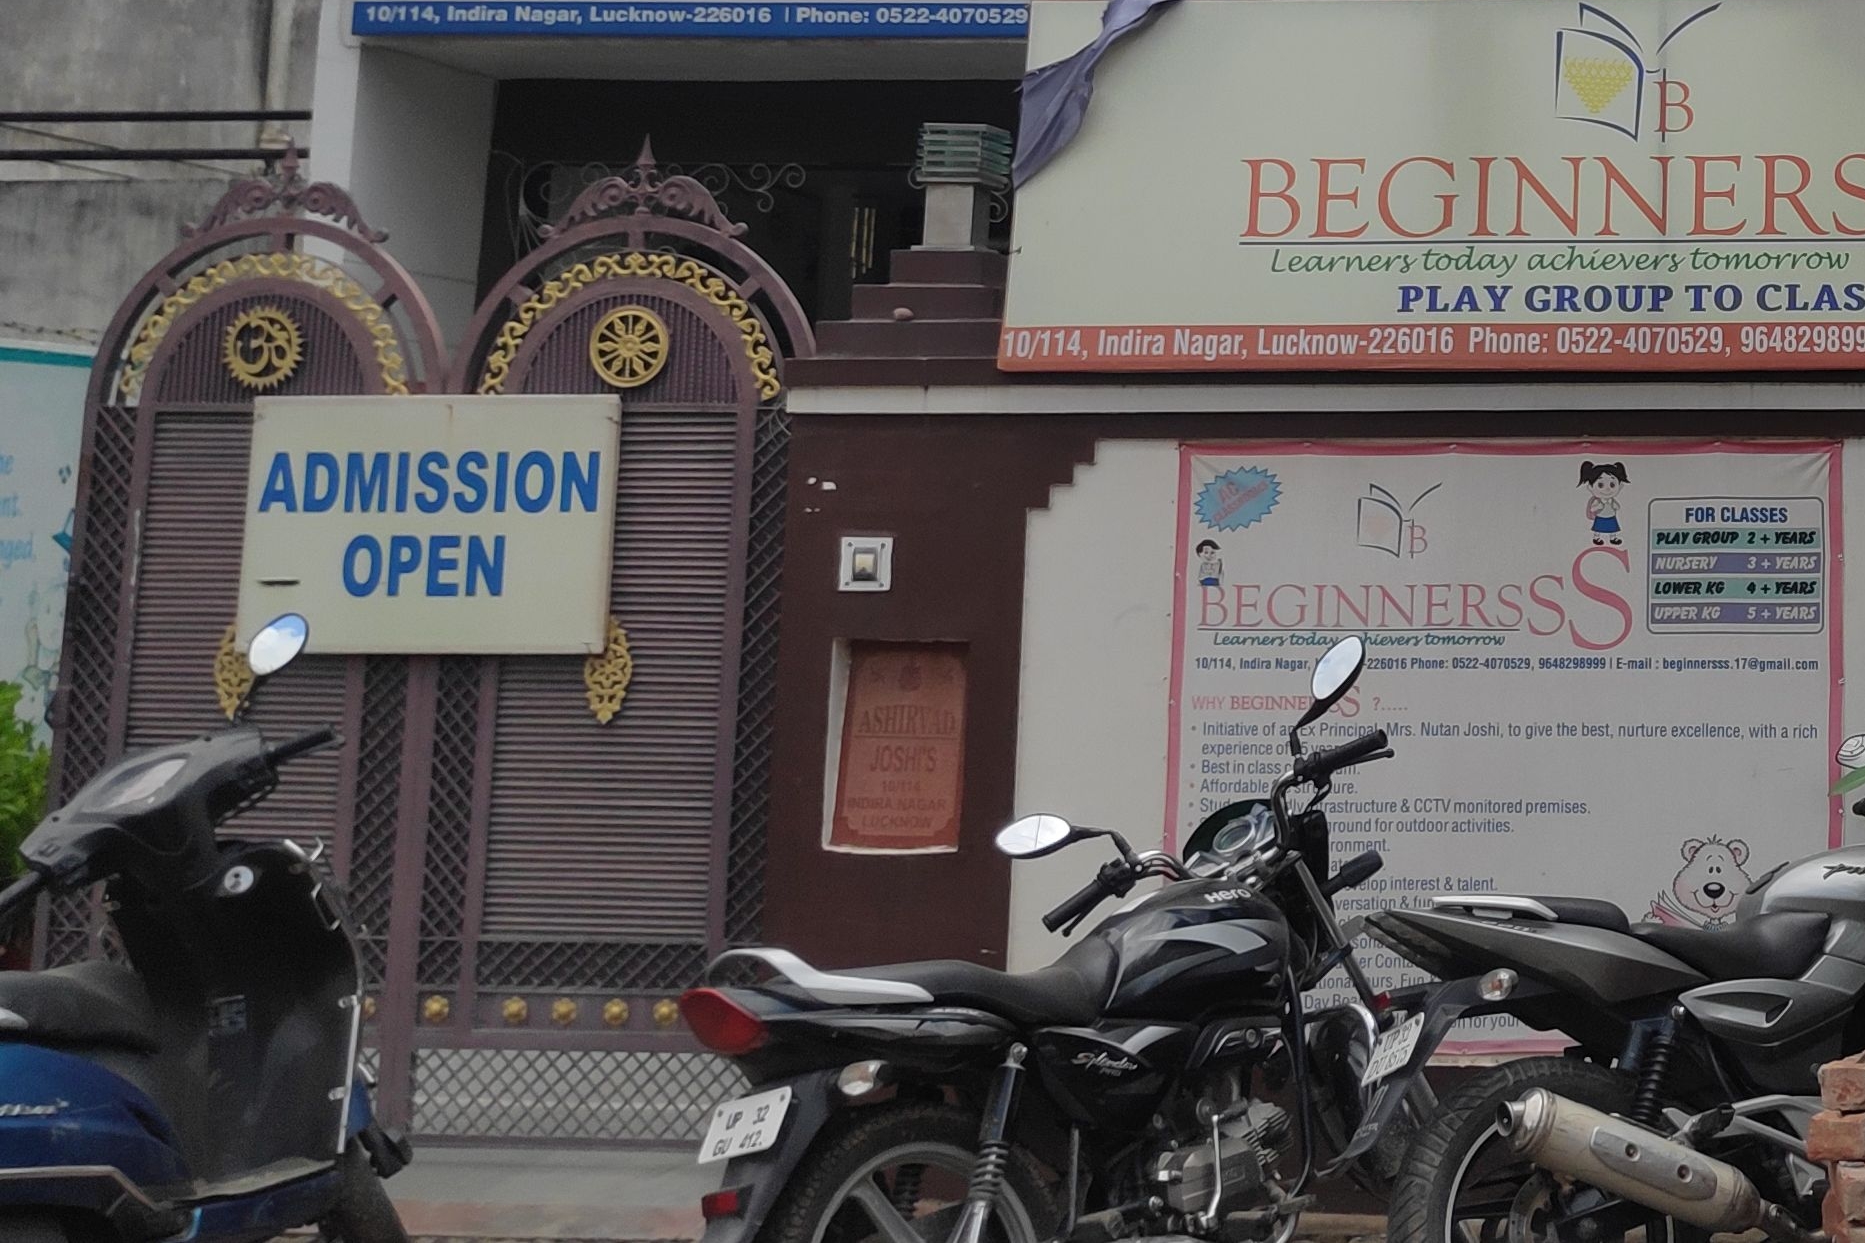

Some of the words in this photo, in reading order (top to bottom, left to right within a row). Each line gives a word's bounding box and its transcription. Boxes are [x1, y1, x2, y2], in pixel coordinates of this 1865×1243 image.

[366, 7, 440, 25] 10/114,
[447, 6, 507, 22] Indira
[515, 6, 583, 25] Nagar,
[590, 7, 771, 23] Lucknow-226016
[796, 8, 869, 23] Phone:
[1271, 247, 1416, 273] Learners
[1422, 247, 1518, 277] today
[1527, 246, 1688, 272] achievers
[1691, 248, 1849, 271] tomorrow
[1397, 285, 1513, 312] PLAY
[1524, 285, 1673, 313] GROUP
[1685, 284, 1742, 313] TO
[1004, 331, 1088, 360] 10/114,
[1098, 329, 1164, 357] Indira
[1174, 331, 1247, 361] Nagar,
[1258, 326, 1453, 356] Lucknow-226016
[1468, 328, 1549, 354] Phone:
[1557, 326, 1731, 359] 0522-4070529,
[258, 450, 601, 513] ADMISSION
[1685, 508, 1715, 523] FOR
[1720, 507, 1788, 523] CLASSES
[1656, 531, 1690, 544] PLAY
[1692, 531, 1739, 545] GROUP
[1774, 531, 1816, 544] YEARS
[342, 534, 505, 597] OPEN
[1655, 556, 1717, 569] NURSERY
[1775, 556, 1816, 569] YEARS
[1654, 582, 1702, 595] LOWER
[1706, 581, 1725, 594] KG
[1197, 546, 1633, 651] BEGINNERSSS
[1654, 607, 1697, 619] UPPER
[1701, 607, 1721, 619] KG
[1196, 658, 1236, 671] 10/114,
[1239, 658, 1273, 669] Indira
[1275, 658, 1311, 672] Nagar,
[1411, 657, 1448, 669] Phone:
[1452, 657, 1534, 671] 0522-4070529,
[1539, 658, 1606, 669] 9648298999
[1662, 657, 1818, 672] beginnersss.17@gmail.com
[1192, 697, 1225, 709] WHY
[1203, 723, 1259, 736] Initiative
[1387, 723, 1416, 736] Mrs.
[1420, 723, 1459, 736] Nutan
[1464, 722, 1504, 738] Joshi,
[1525, 723, 1553, 739] give
[1557, 723, 1577, 736] the
[1581, 723, 1613, 739] best,
[1618, 725, 1667, 738] nurture
[1671, 723, 1744, 739] excellence,
[1749, 723, 1777, 738] with
[1793, 723, 1818, 738] rich
[1202, 742, 1273, 756] experience
[1202, 761, 1230, 774] Best
[1248, 761, 1280, 773] class
[1200, 780, 1268, 793] Affordable
[1414, 799, 1451, 812] CCTV
[1453, 799, 1524, 815] monitored
[1525, 800, 1591, 816] premises.
[1397, 819, 1448, 832] outdoor
[1452, 819, 1514, 833] activities.
[1390, 877, 1442, 891] interest
[1457, 878, 1497, 891] talent.
[1204, 888, 1252, 903] Hero
